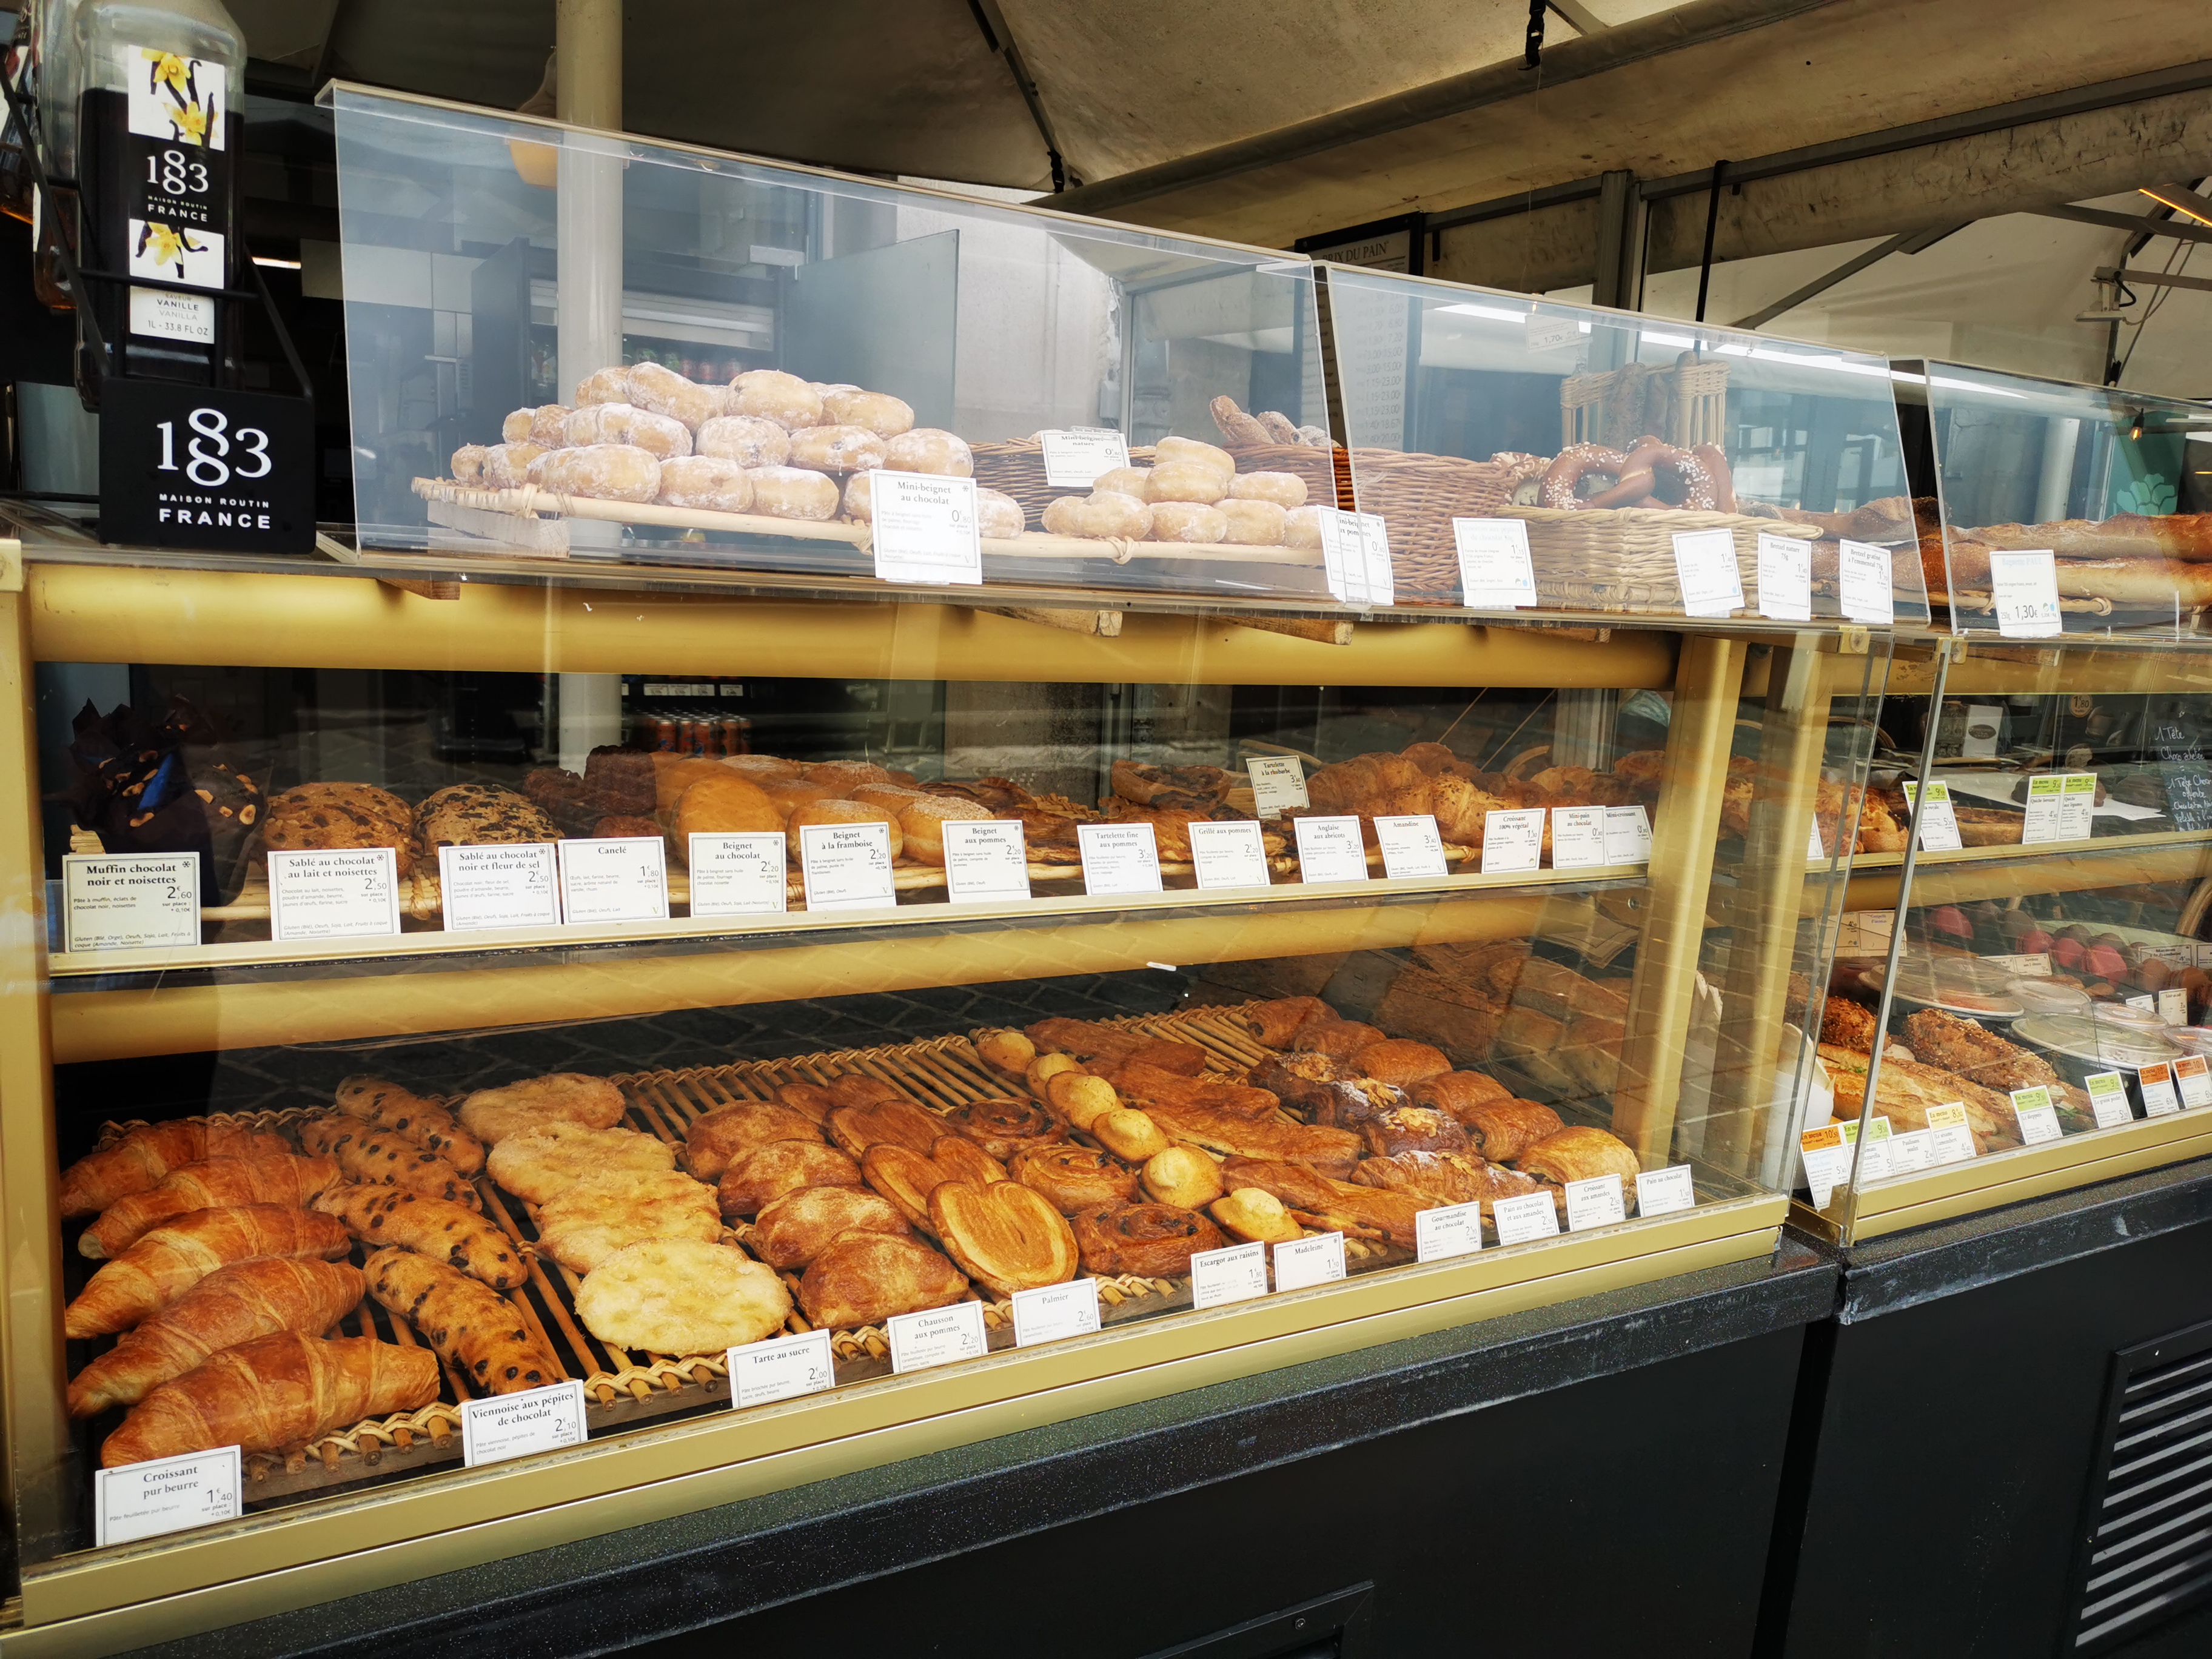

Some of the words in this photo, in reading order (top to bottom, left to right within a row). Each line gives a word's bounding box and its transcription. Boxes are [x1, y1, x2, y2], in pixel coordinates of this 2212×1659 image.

[148, 195, 176, 204] MAISON
[181, 201, 207, 210] ROUTIN
[148, 204, 208, 222] FRANCE
[1346, 248, 1361, 260] DU
[1362, 241, 1388, 258] PAIN
[156, 299, 199, 311] VANILLE
[159, 309, 198, 320] VANILLA
[149, 320, 156, 328] 1L
[166, 322, 181, 332] 33.8
[185, 325, 194, 333] FL
[197, 327, 208, 336] OZ
[897, 481, 951, 495] Mini-beignet
[159, 494, 212, 504] MAISON
[220, 498, 269, 508] ROUTIN
[914, 494, 950, 504] chocolat
[159, 508, 270, 529] FRANCE
[1851, 549, 1866, 557] Bretzel
[2002, 557, 2025, 568] Baguette
[833, 832, 860, 840] Beignet
[723, 842, 752, 851] Beignet
[289, 858, 316, 867] Sablé
[460, 853, 484, 861] Sablé
[87, 865, 126, 874] Muffin
[130, 863, 177, 873] chocolat
[335, 868, 377, 876] noisettes
[87, 877, 111, 886] noir
[129, 876, 176, 885] noisettes
[1584, 1184, 1605, 1192] Croissant
[1590, 1191, 1610, 1200] amandes
[1432, 1211, 1466, 1222] Gourmandise
[1523, 1209, 1544, 1218] amandes
[1443, 1220, 1464, 1228] chocolat
[1295, 1244, 1323, 1255] Madeleine
[1201, 1257, 1225, 1267] Escargot
[1240, 1250, 1259, 1259] raisins
[1042, 1294, 1068, 1304] Palmier
[918, 1316, 953, 1327] Chausson
[930, 1325, 960, 1338] pommes
[752, 1354, 774, 1364] Tarte
[789, 1347, 810, 1356] sucre
[472, 1404, 519, 1419] Viennoise
[522, 1400, 539, 1409] aux
[541, 1393, 574, 1407] pépites
[498, 1417, 509, 1426] de
[512, 1409, 551, 1423] chocolat
[143, 1466, 198, 1483] Croissant
[143, 1488, 162, 1500] pur
[165, 1480, 198, 1493] beurre
